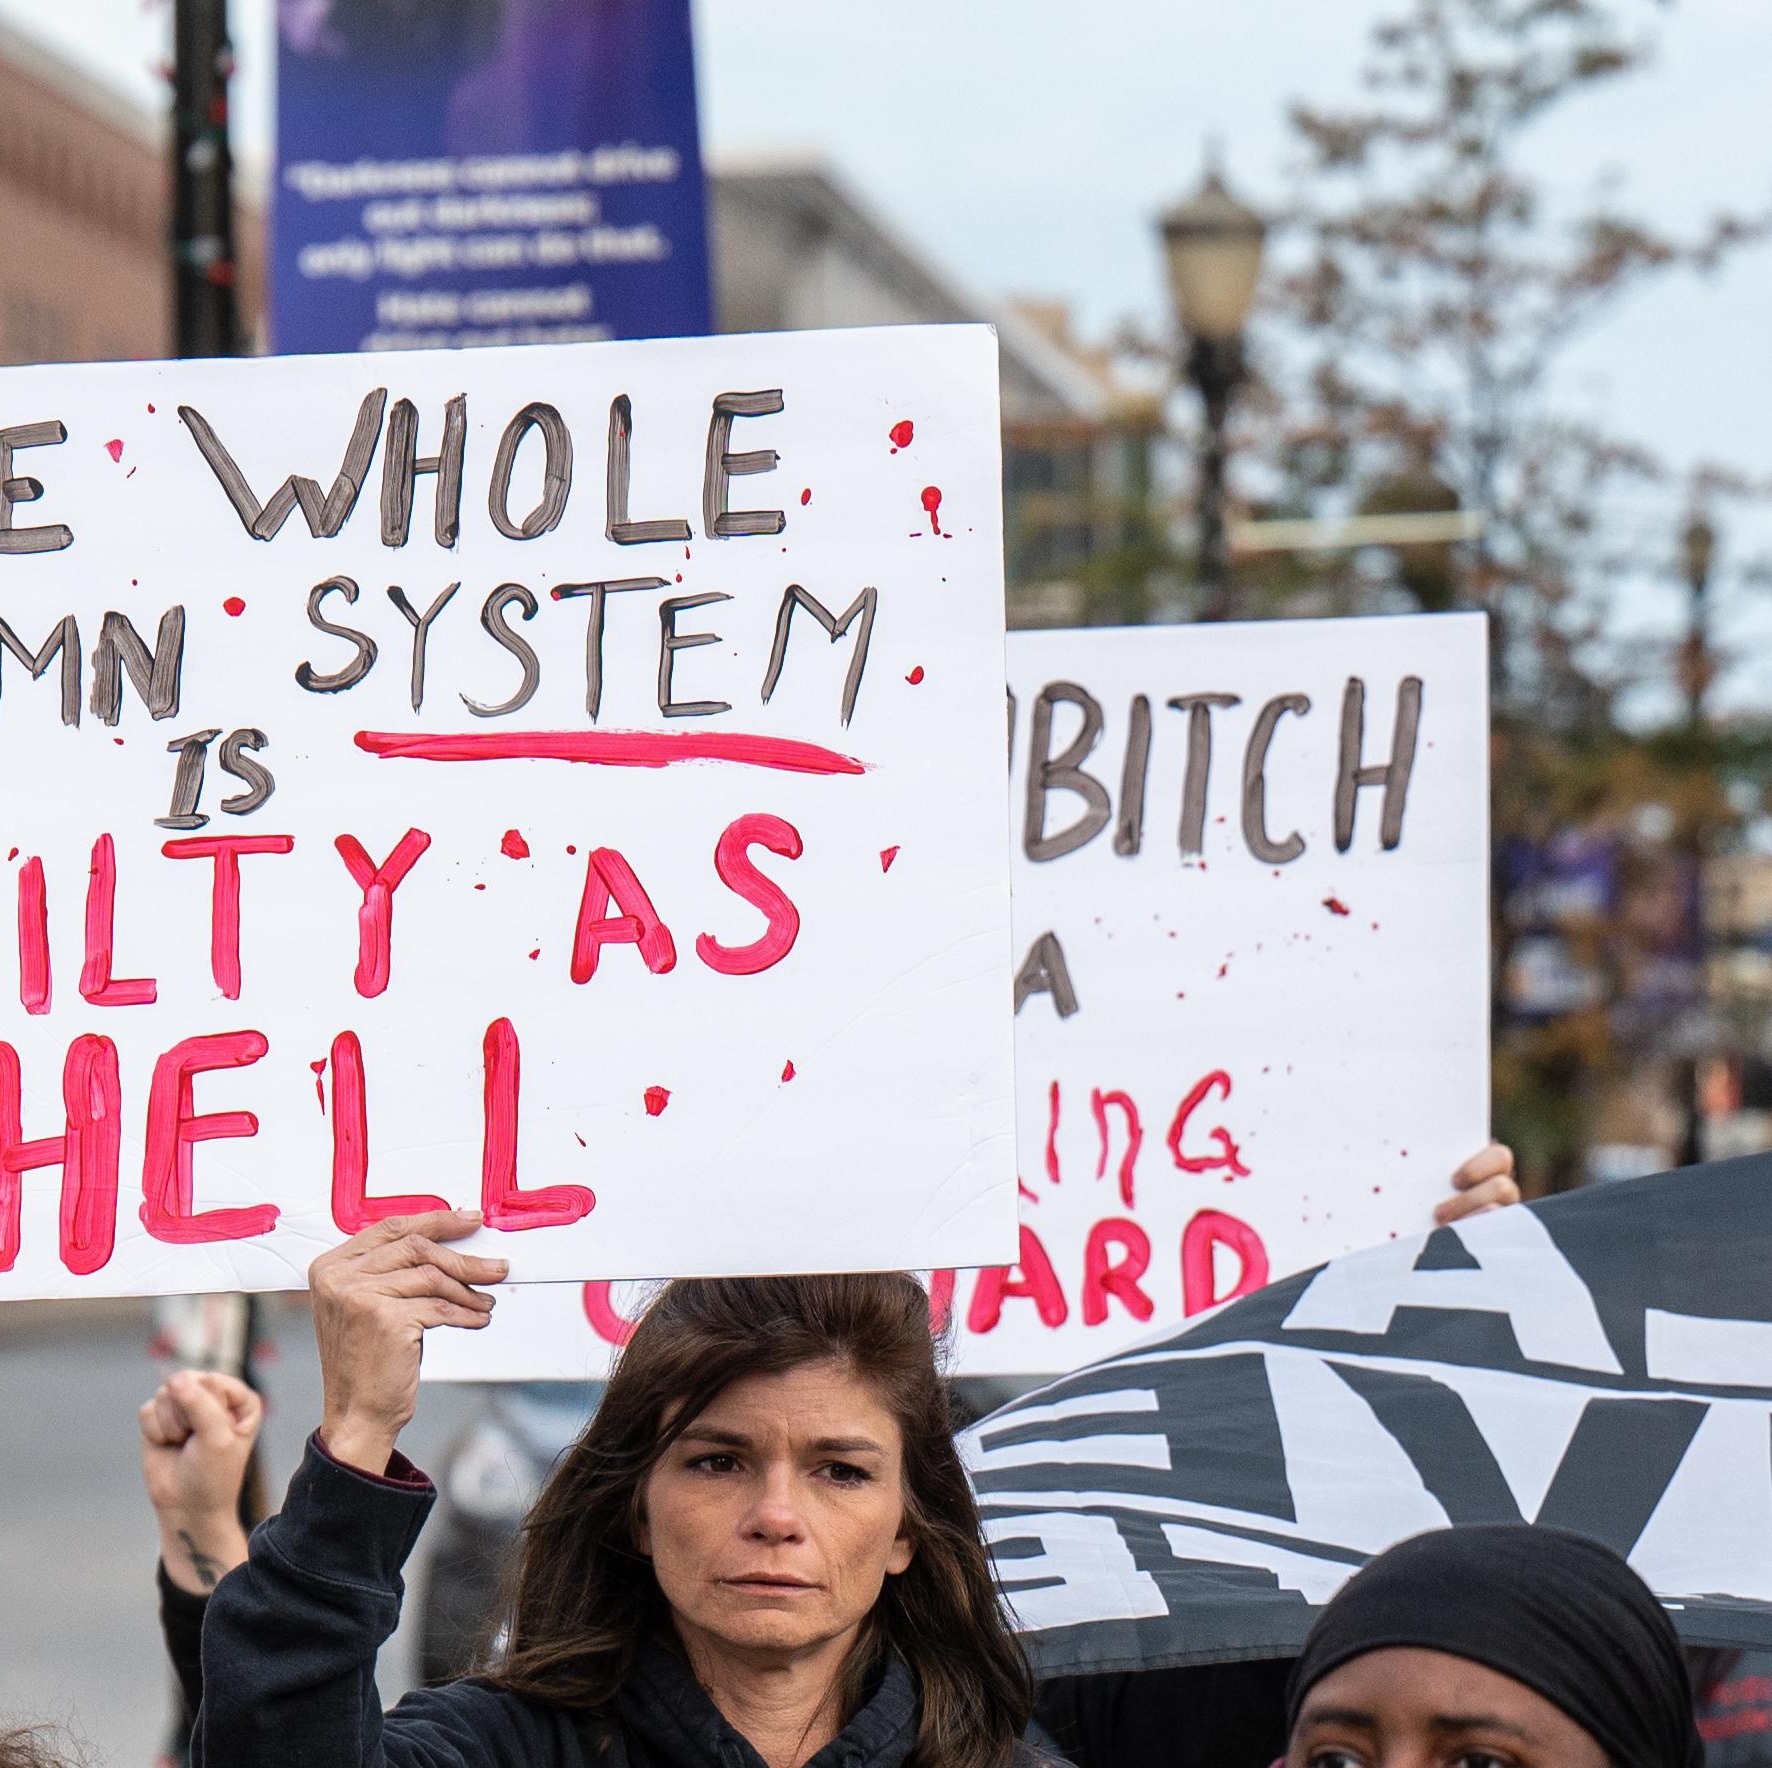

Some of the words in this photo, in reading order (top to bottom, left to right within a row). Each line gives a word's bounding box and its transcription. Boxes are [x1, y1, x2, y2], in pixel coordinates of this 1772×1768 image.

[177, 386, 787, 551] WHOLE
[294, 575, 878, 729] SYSTEM
[154, 728, 276, 831] IS
[1006, 676, 1424, 866] BITCH
[569, 812, 804, 986] AS
[928, 1205, 1271, 1336] ARD
